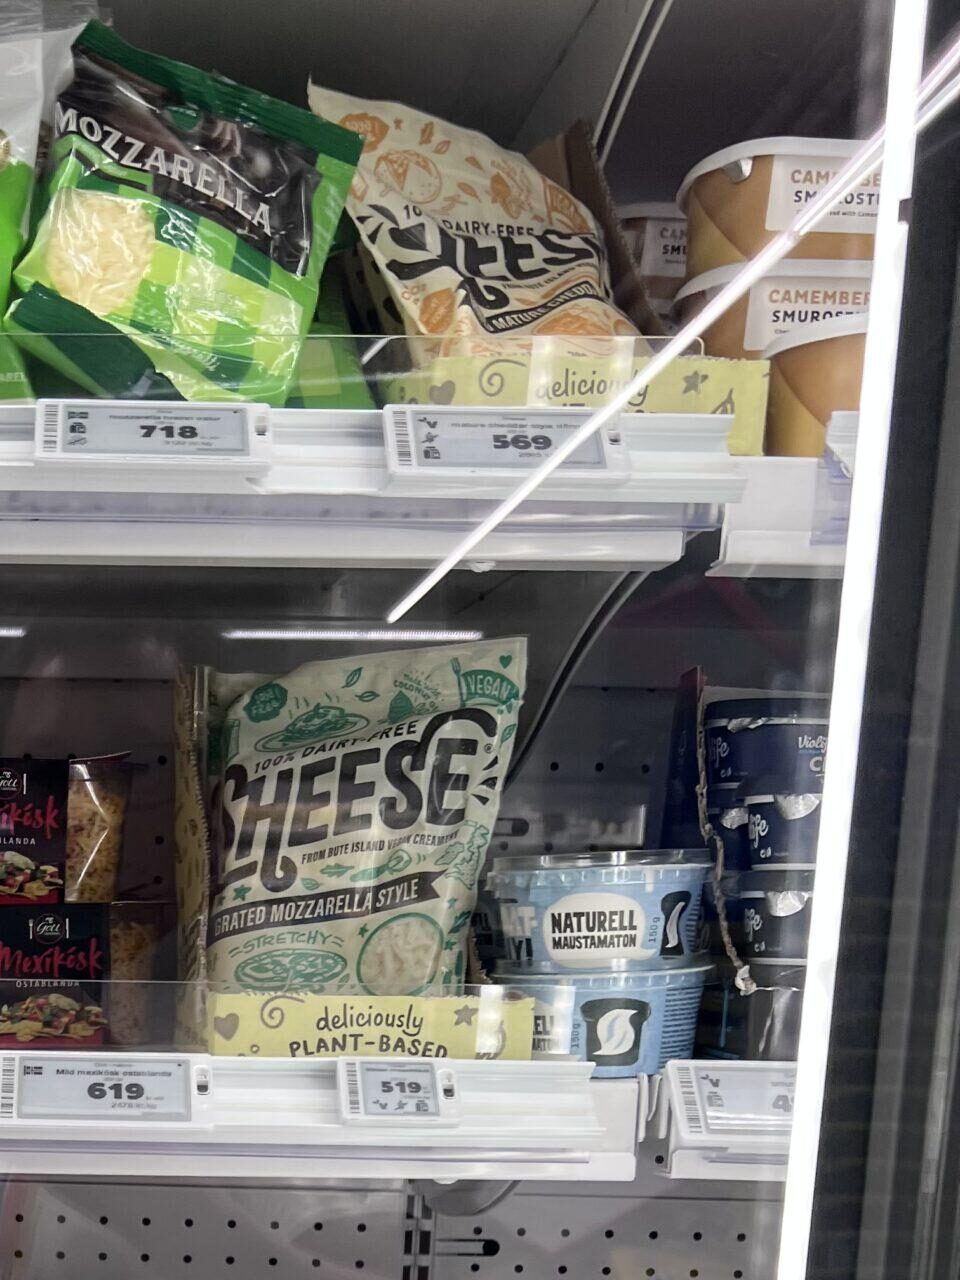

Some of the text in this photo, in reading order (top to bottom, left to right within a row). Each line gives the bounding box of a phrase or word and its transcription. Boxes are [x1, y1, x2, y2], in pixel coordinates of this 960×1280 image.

[56, 102, 272, 238] MOZZARELLA
[140, 425, 198, 438] 718
[493, 434, 552, 450] 569
[467, 674, 509, 699] VEGAN
[253, 720, 419, 774] 100% DAIRY-FREE
[302, 851, 327, 866] FROM
[327, 845, 351, 860] BUTE
[351, 839, 386, 854] ISLAND
[214, 878, 420, 937] GRATED MOZZARELLA STYLE
[551, 909, 638, 934] NATURELL
[243, 929, 334, 954] STRETCHY
[551, 933, 637, 950] MAUSTAMATON
[15, 980, 80, 988] OSTABLANDA
[315, 1004, 424, 1038] deliciously
[288, 1033, 448, 1058] PLANT-BASED
[87, 1082, 145, 1100] 619
[381, 1081, 422, 1093] 519
[772, 1094, 795, 1113] 4
